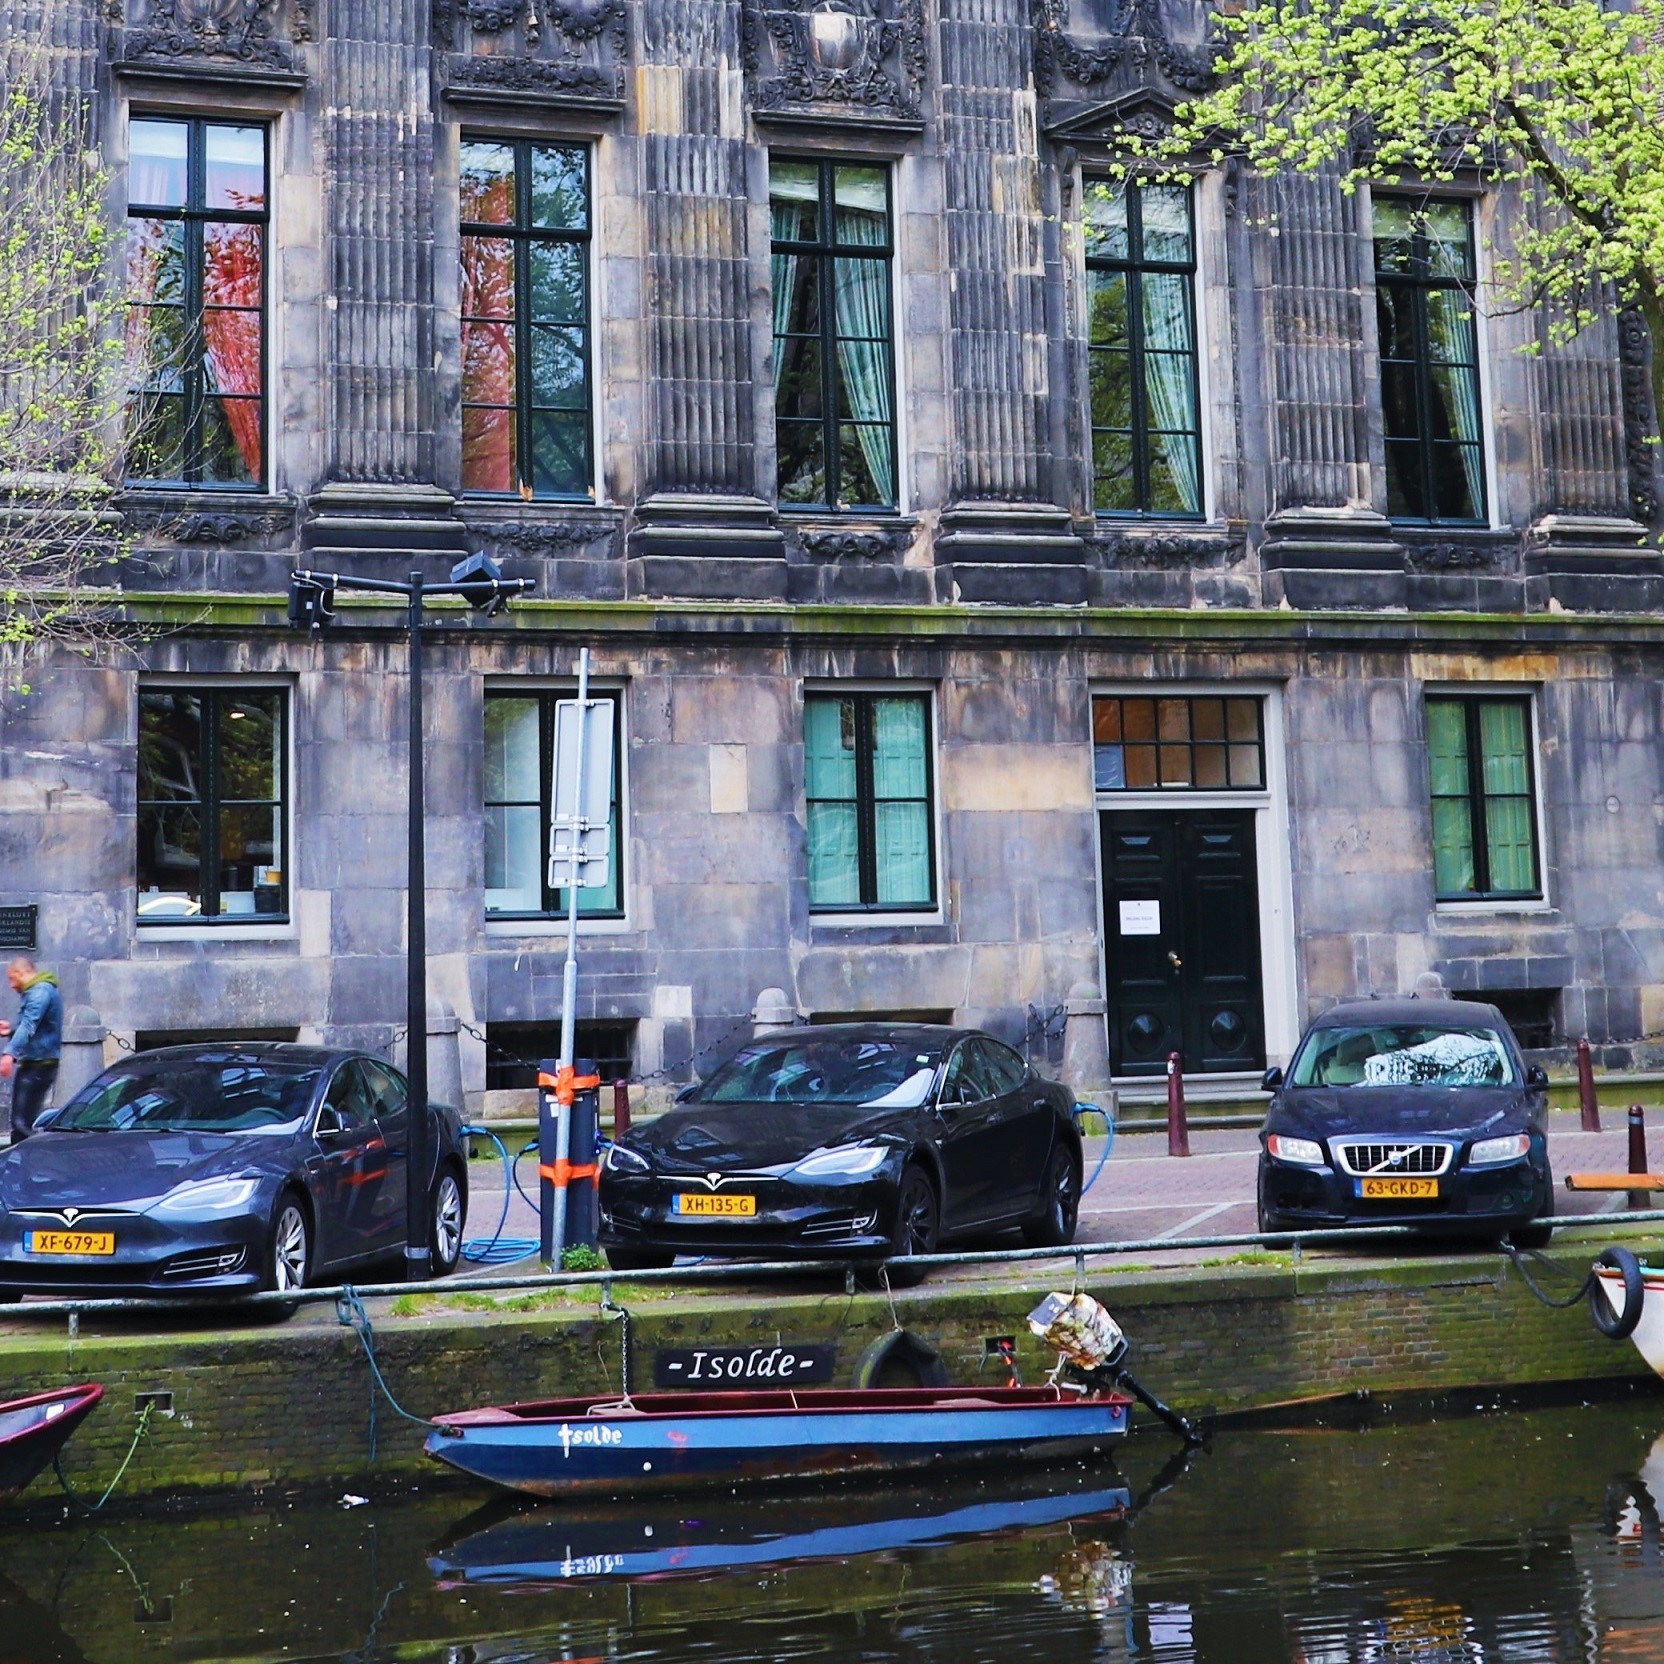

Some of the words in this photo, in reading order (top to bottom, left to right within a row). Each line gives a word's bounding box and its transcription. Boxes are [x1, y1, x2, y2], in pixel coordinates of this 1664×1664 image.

[1366, 1181, 1432, 1195] 63-GKD-7
[686, 1197, 748, 1212] XH-135-G
[40, 1235, 107, 1251] XF-679-J
